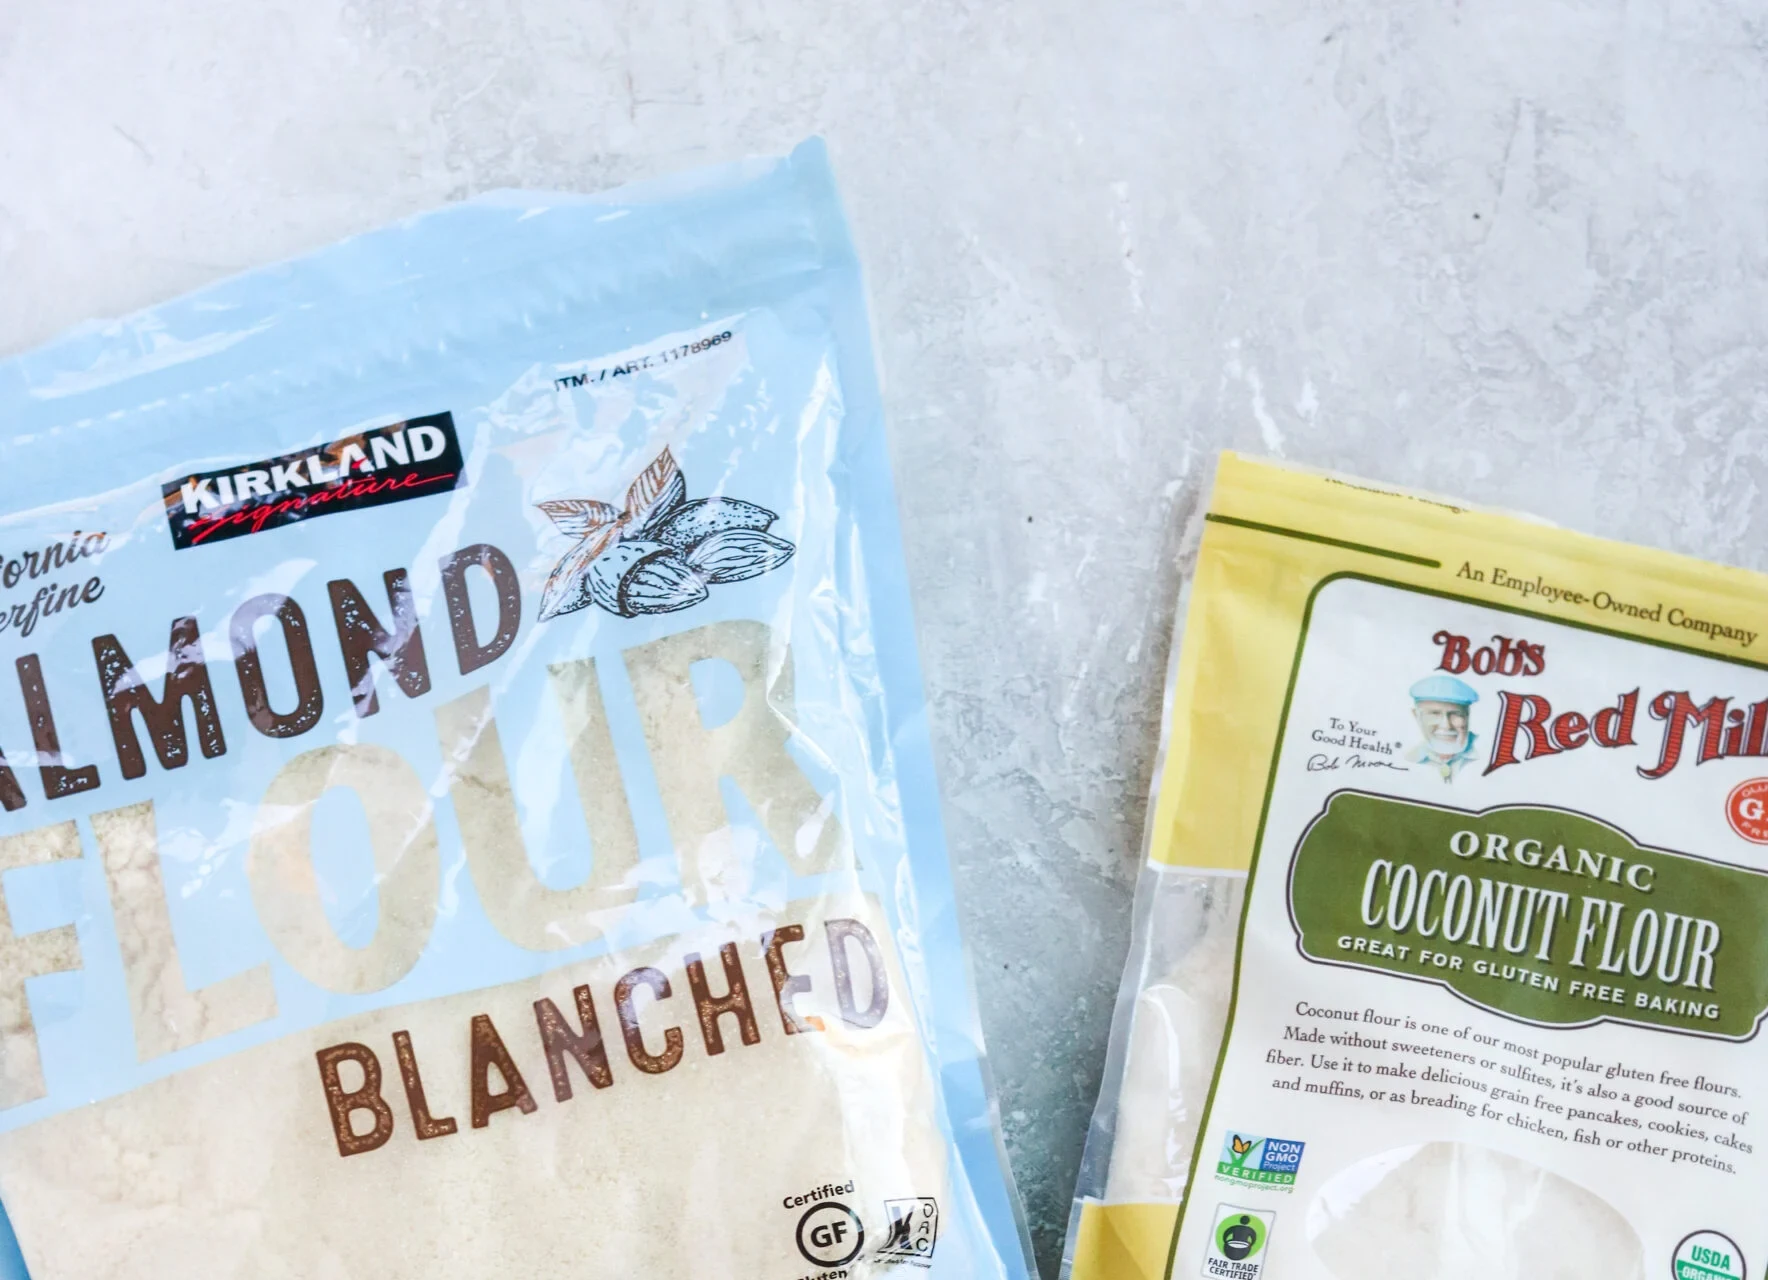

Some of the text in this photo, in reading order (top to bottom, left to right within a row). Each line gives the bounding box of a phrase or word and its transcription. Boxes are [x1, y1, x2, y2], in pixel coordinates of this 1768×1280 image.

[663, 331, 732, 362] 1178969
[180, 426, 446, 514] KIRKLAND
[0, 531, 110, 588] ornia
[1456, 562, 1758, 647] An Employee-Owned Company
[0, 543, 522, 811] LMOND
[1433, 630, 1545, 676] Bob's
[1312, 730, 1345, 747] Good
[1330, 718, 1378, 736] To Your
[1482, 687, 1639, 776] Red
[0, 618, 861, 1108] FLOUR
[1450, 830, 1656, 893] ORGANIC
[1360, 859, 1721, 990] COCONUT FLOUR
[1337, 935, 1720, 1019] GREAT FOR GLUTEN FREE BAKING
[316, 918, 889, 1157] BLANCHED
[1296, 1002, 1741, 1098] Coconut flour is one of our most popular gluten free flours.
[1283, 1026, 1749, 1126] Made without sweeteners or sulfites, it's also a good source of
[1263, 1161, 1296, 1172] Project
[1265, 1152, 1298, 1163] GMO
[1268, 1142, 1301, 1154] NON
[783, 1180, 854, 1209] Certified
[1222, 1165, 1293, 1183] VERIFIED
[811, 1221, 847, 1248] GF
[1691, 1245, 1730, 1270] USDA
[1208, 1258, 1258, 1273] FAIR TRADE
